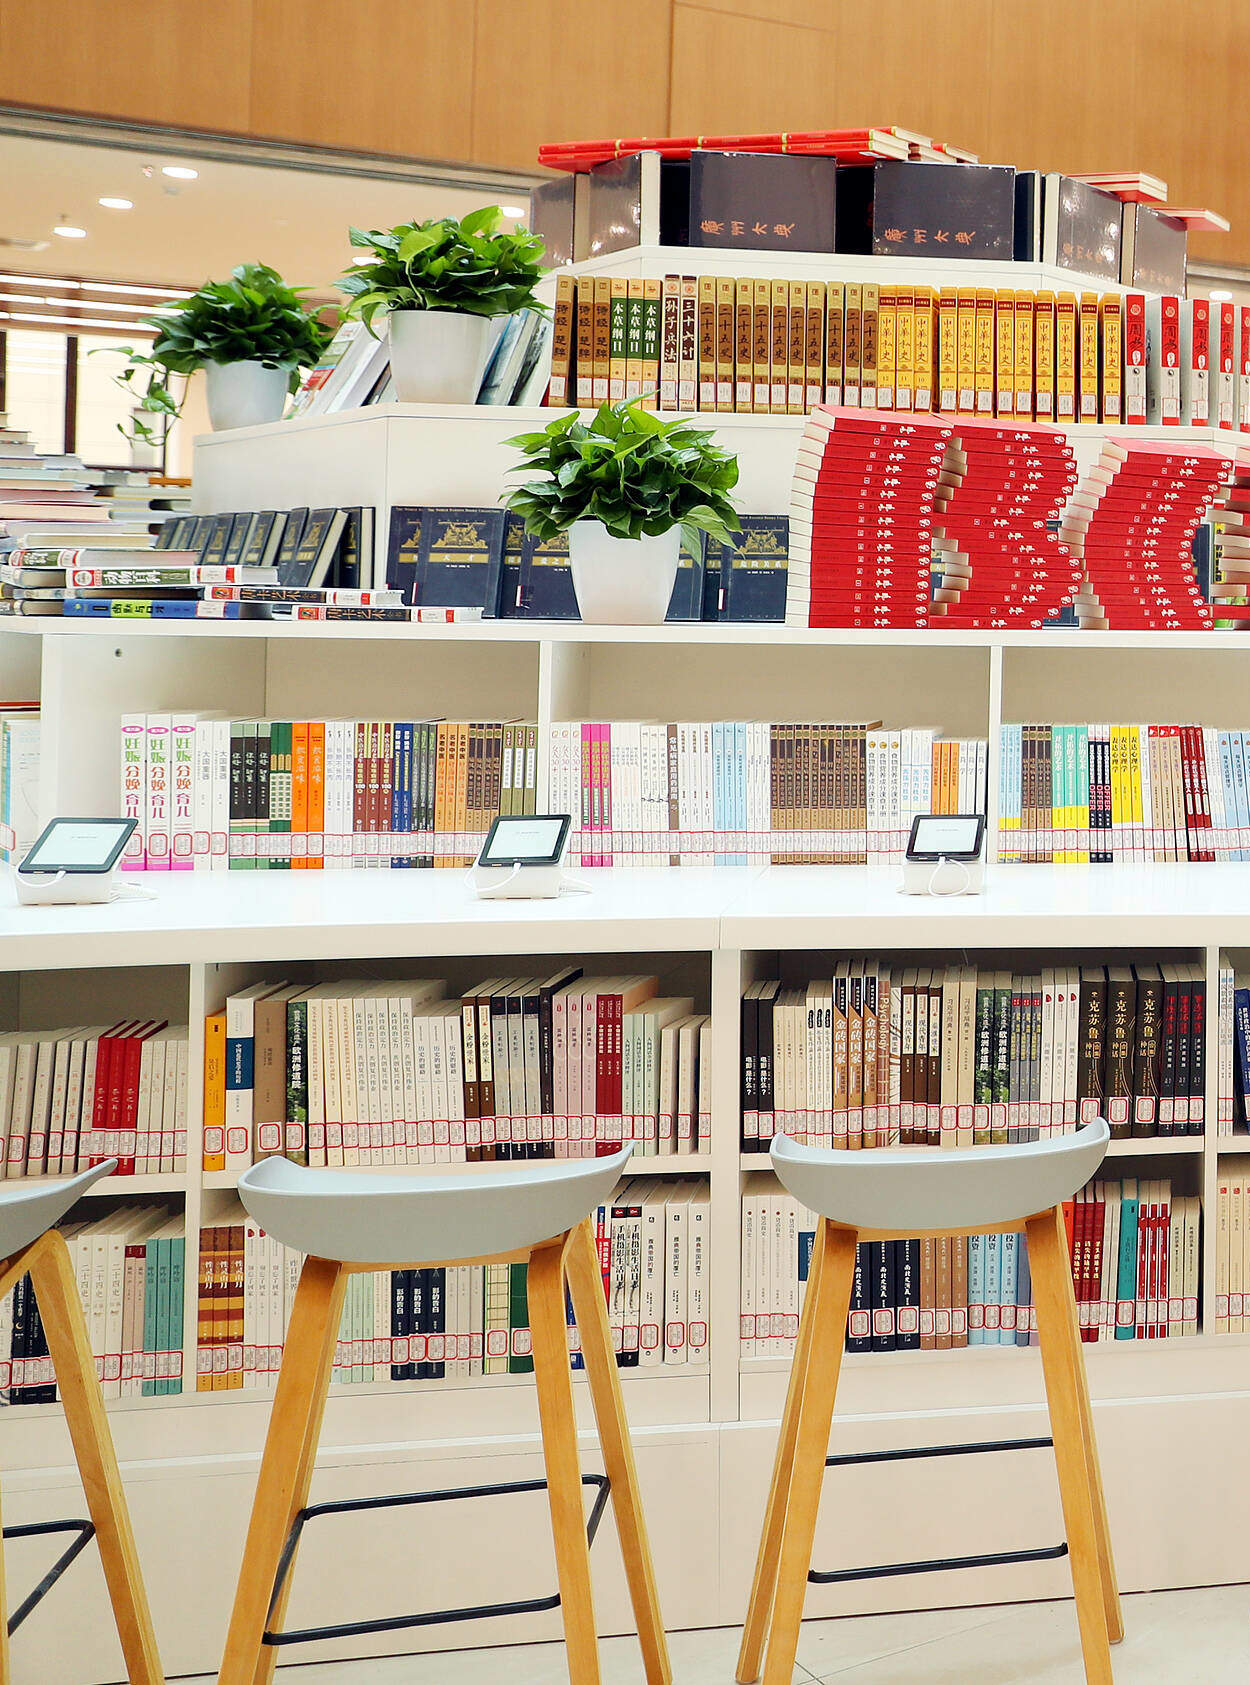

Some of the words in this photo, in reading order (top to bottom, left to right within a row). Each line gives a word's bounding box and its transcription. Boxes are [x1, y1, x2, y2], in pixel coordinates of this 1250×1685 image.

[612, 302, 624, 352] 本草纲目
[629, 303, 640, 352] 本草纲目
[644, 304, 656, 354] 本草纲目
[664, 300, 678, 361] 孙子兵法
[682, 301, 695, 359] 三十六计
[701, 306, 714, 358] 二十五史
[719, 308, 732, 358] 二十五史
[738, 308, 751, 359] 二十五史
[755, 309, 768, 359] 二十五史
[773, 310, 786, 360] 二十五史
[790, 311, 803, 361] 二十五史
[808, 312, 820, 362] 二十五史
[829, 312, 841, 362] 二十五史
[846, 312, 859, 363] 二十五史
[863, 314, 876, 365] 二十五史
[125, 738, 141, 819] 妊娠分娩育儿
[150, 739, 166, 819] 妊娠分娩育儿
[176, 737, 192, 818] 妊娠分娩育儿
[878, 998, 890, 1050] Psychology
[1088, 999, 1100, 1039] 克苏鲁
[1115, 1000, 1127, 1039] 克苏鲁
[1143, 999, 1155, 1038] 克苏鲁
